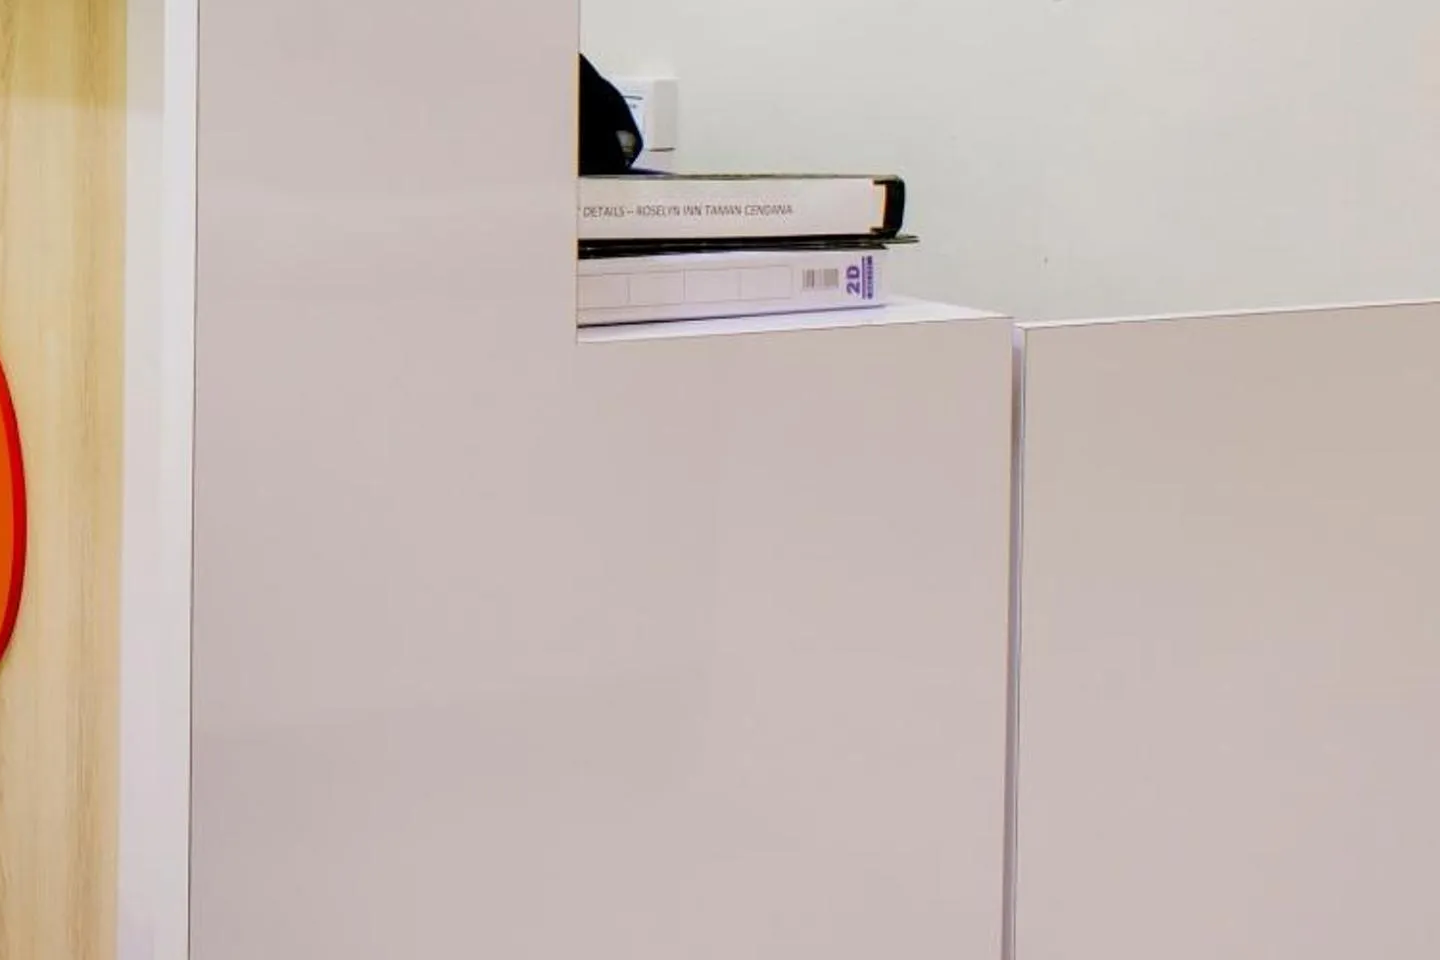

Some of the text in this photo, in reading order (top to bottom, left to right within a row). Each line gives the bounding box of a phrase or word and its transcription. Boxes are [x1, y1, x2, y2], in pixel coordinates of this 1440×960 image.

[582, 205, 625, 218] DETAILS
[682, 204, 702, 216] INN
[704, 203, 742, 216] TAMAN
